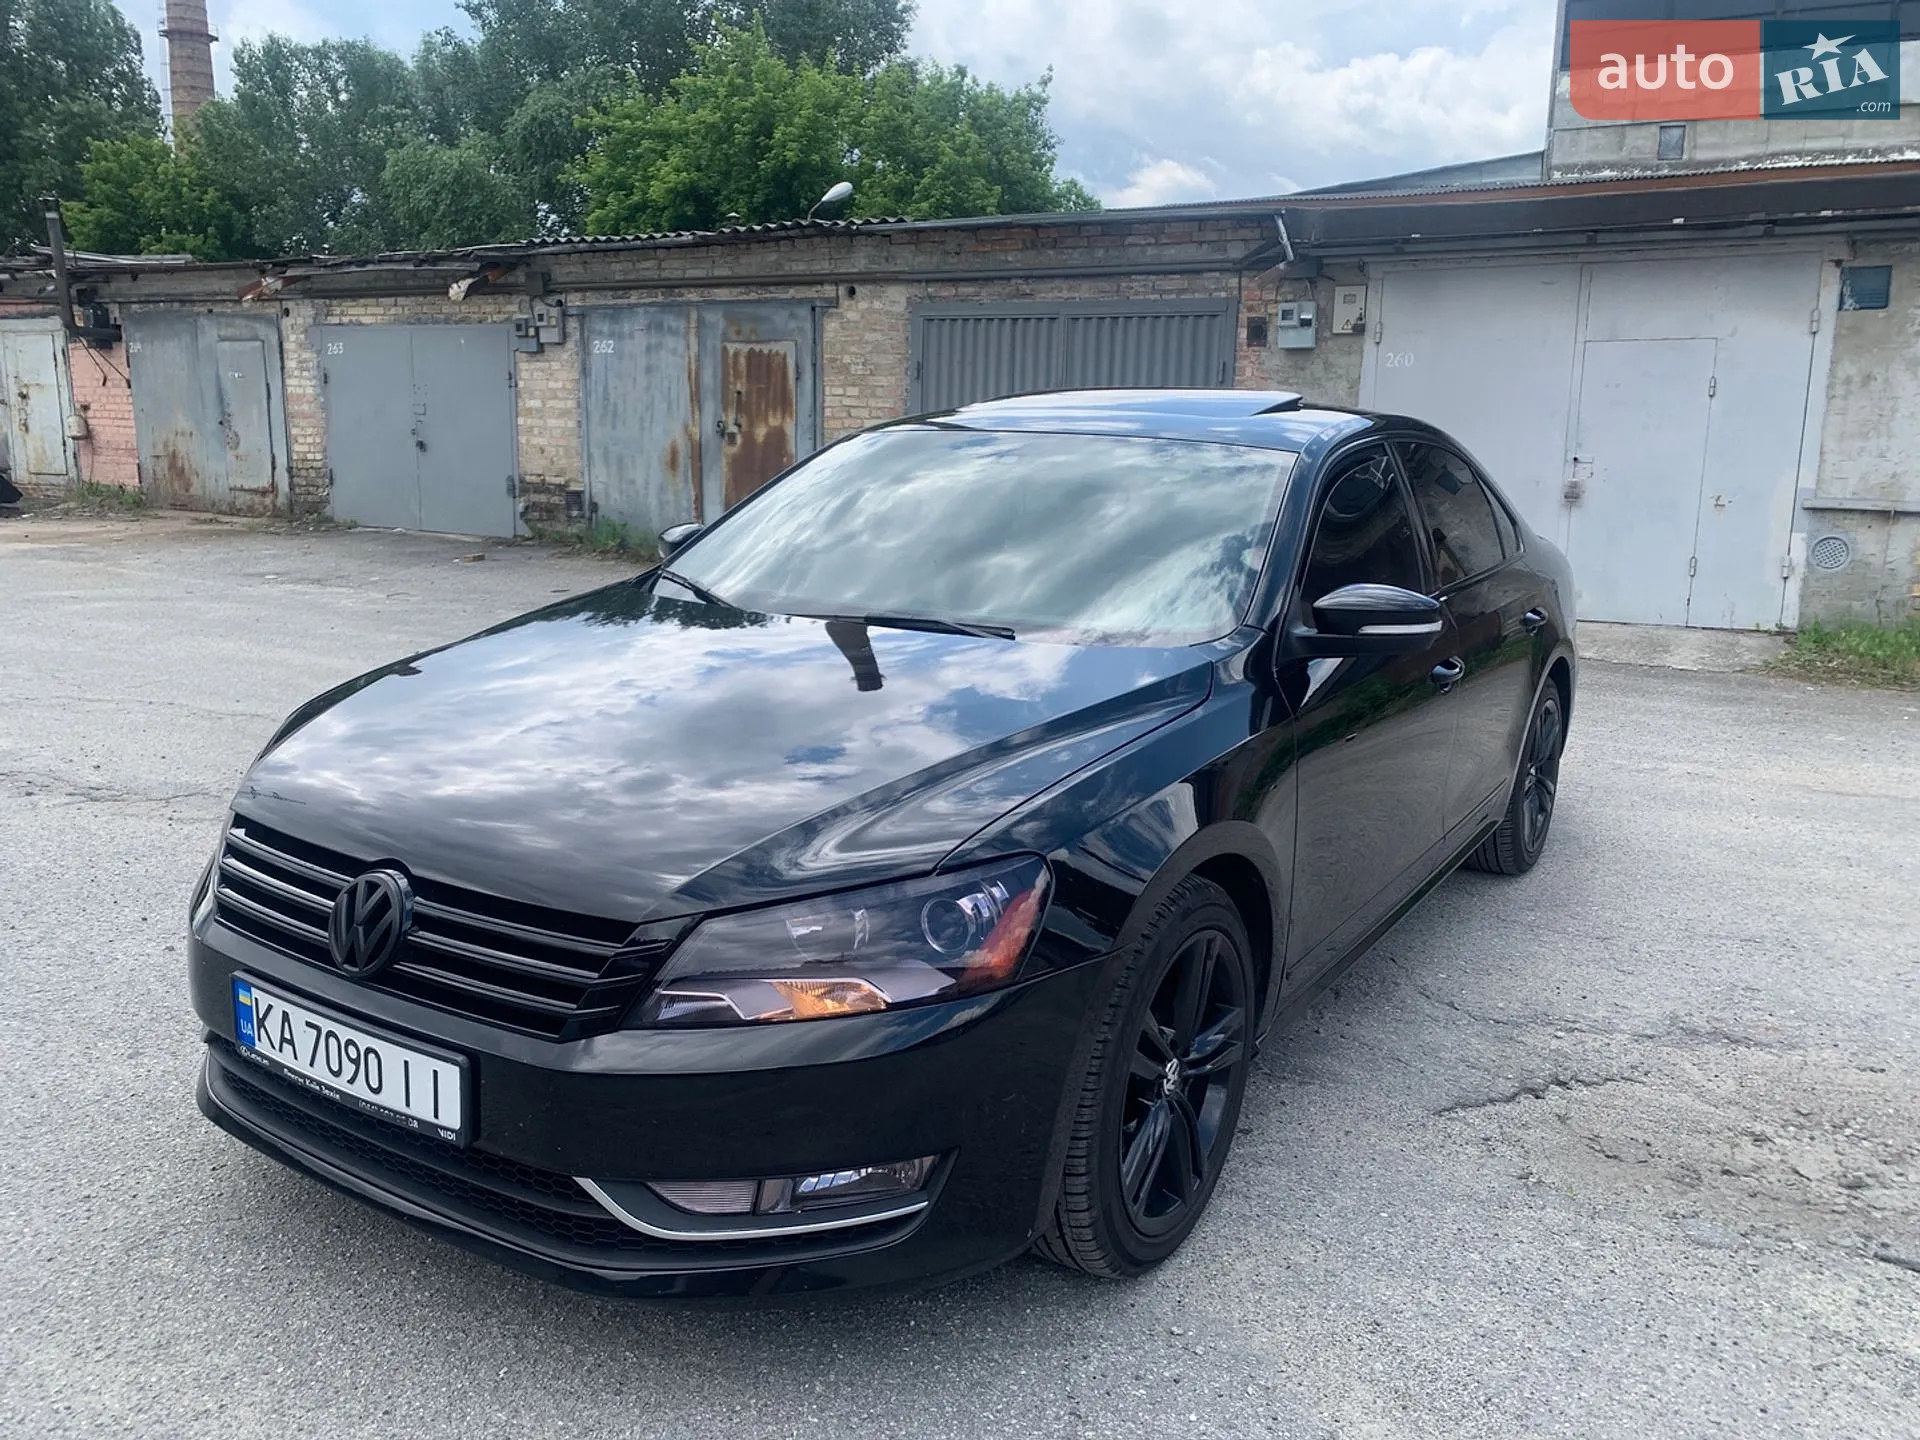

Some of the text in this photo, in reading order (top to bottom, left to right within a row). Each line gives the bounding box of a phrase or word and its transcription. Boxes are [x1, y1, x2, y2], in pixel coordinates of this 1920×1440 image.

[327, 342, 343, 355] 263
[592, 340, 615, 353] 262
[1385, 351, 1414, 367] 260
[240, 1018, 254, 1037] UA
[254, 997, 298, 1061] KA
[305, 1020, 383, 1095] 7090
